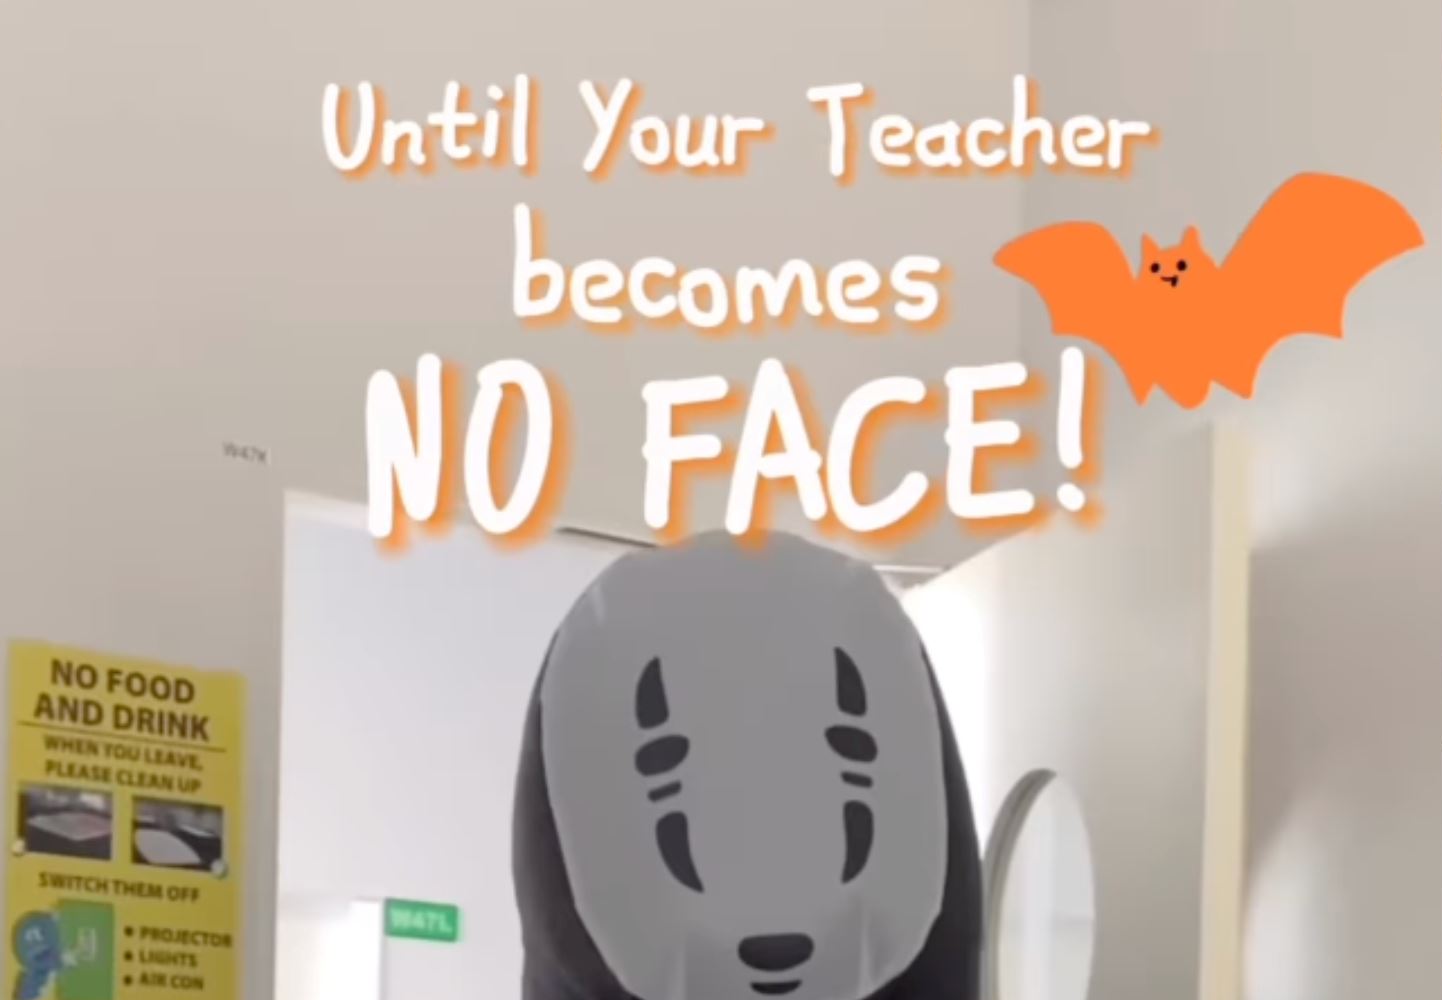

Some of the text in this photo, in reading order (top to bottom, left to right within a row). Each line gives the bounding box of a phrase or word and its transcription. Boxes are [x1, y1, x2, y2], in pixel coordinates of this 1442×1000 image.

[51, 659, 195, 704] NO FOOD
[34, 693, 210, 743] AND DRINK
[44, 735, 100, 756] WHEN
[104, 744, 140, 762] YOU
[45, 760, 203, 793] PLEASE CLEAN UP
[38, 872, 199, 901] SWITCH THEM OFF
[139, 926, 233, 948] PROJECTOR
[139, 951, 199, 968] LIGHTS
[139, 972, 205, 991] AIR CON
